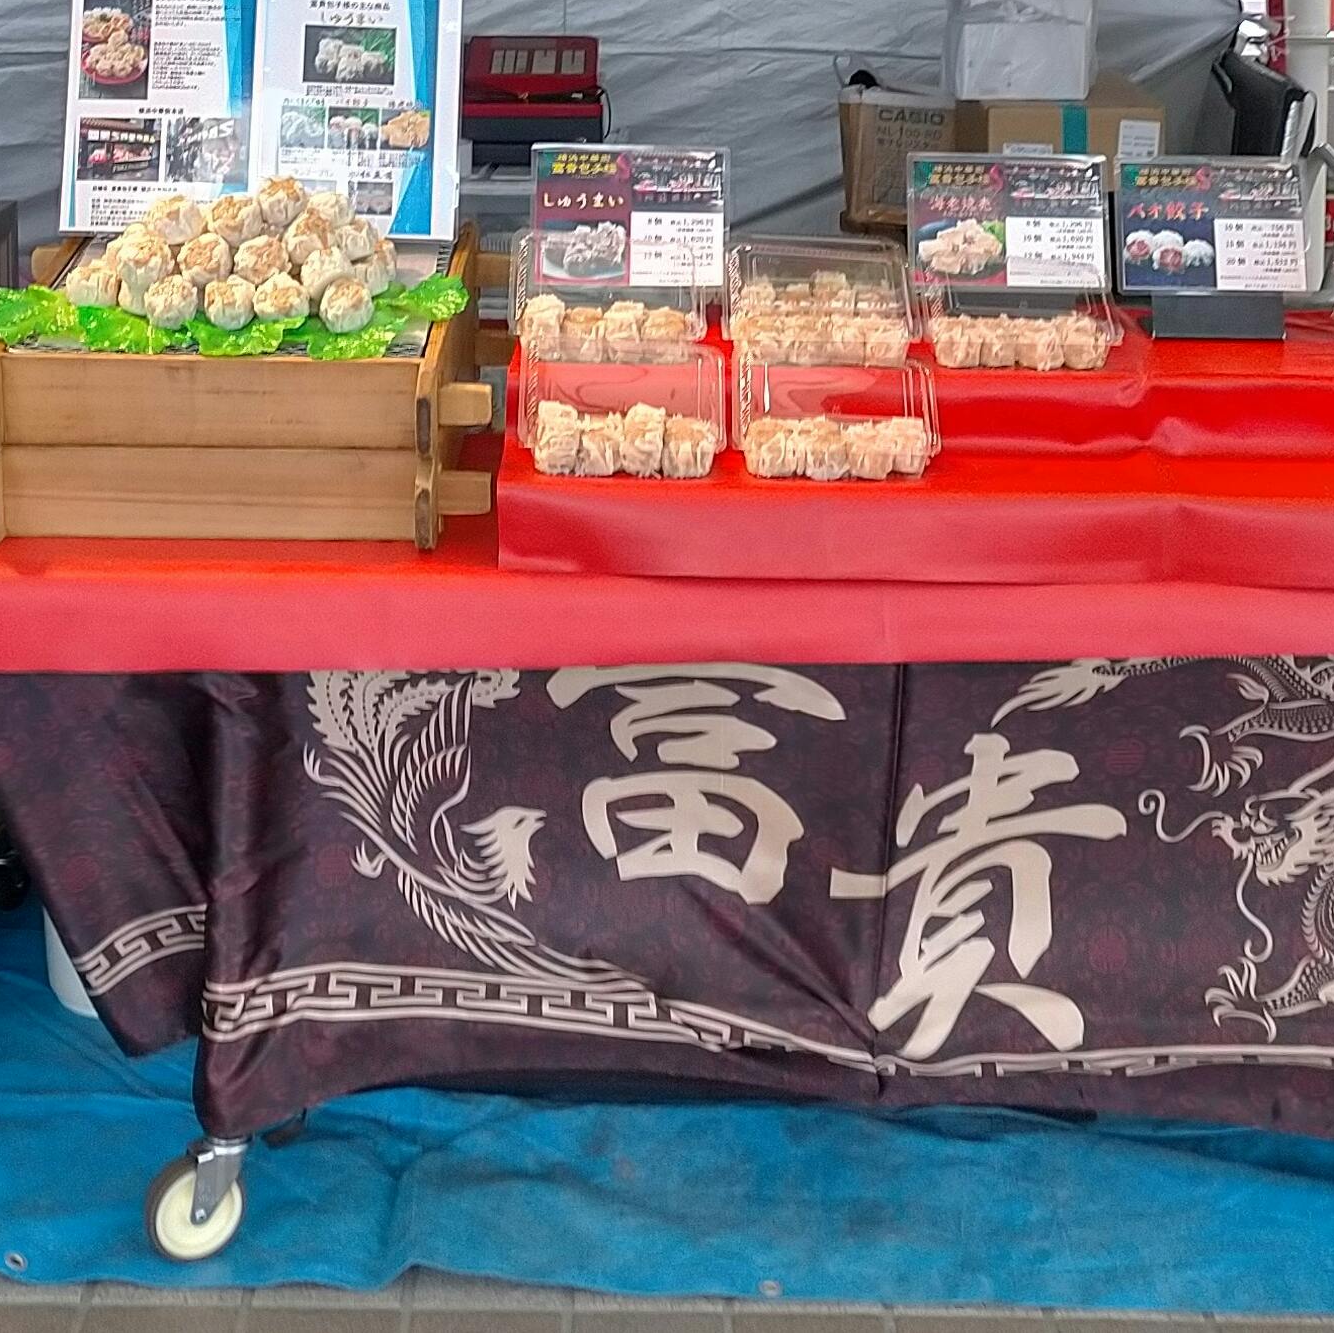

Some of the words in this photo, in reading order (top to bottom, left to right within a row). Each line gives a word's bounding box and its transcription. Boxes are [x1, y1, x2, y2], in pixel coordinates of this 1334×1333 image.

[879, 108, 945, 126] CASIO
[543, 191, 625, 211] しゅうまい
